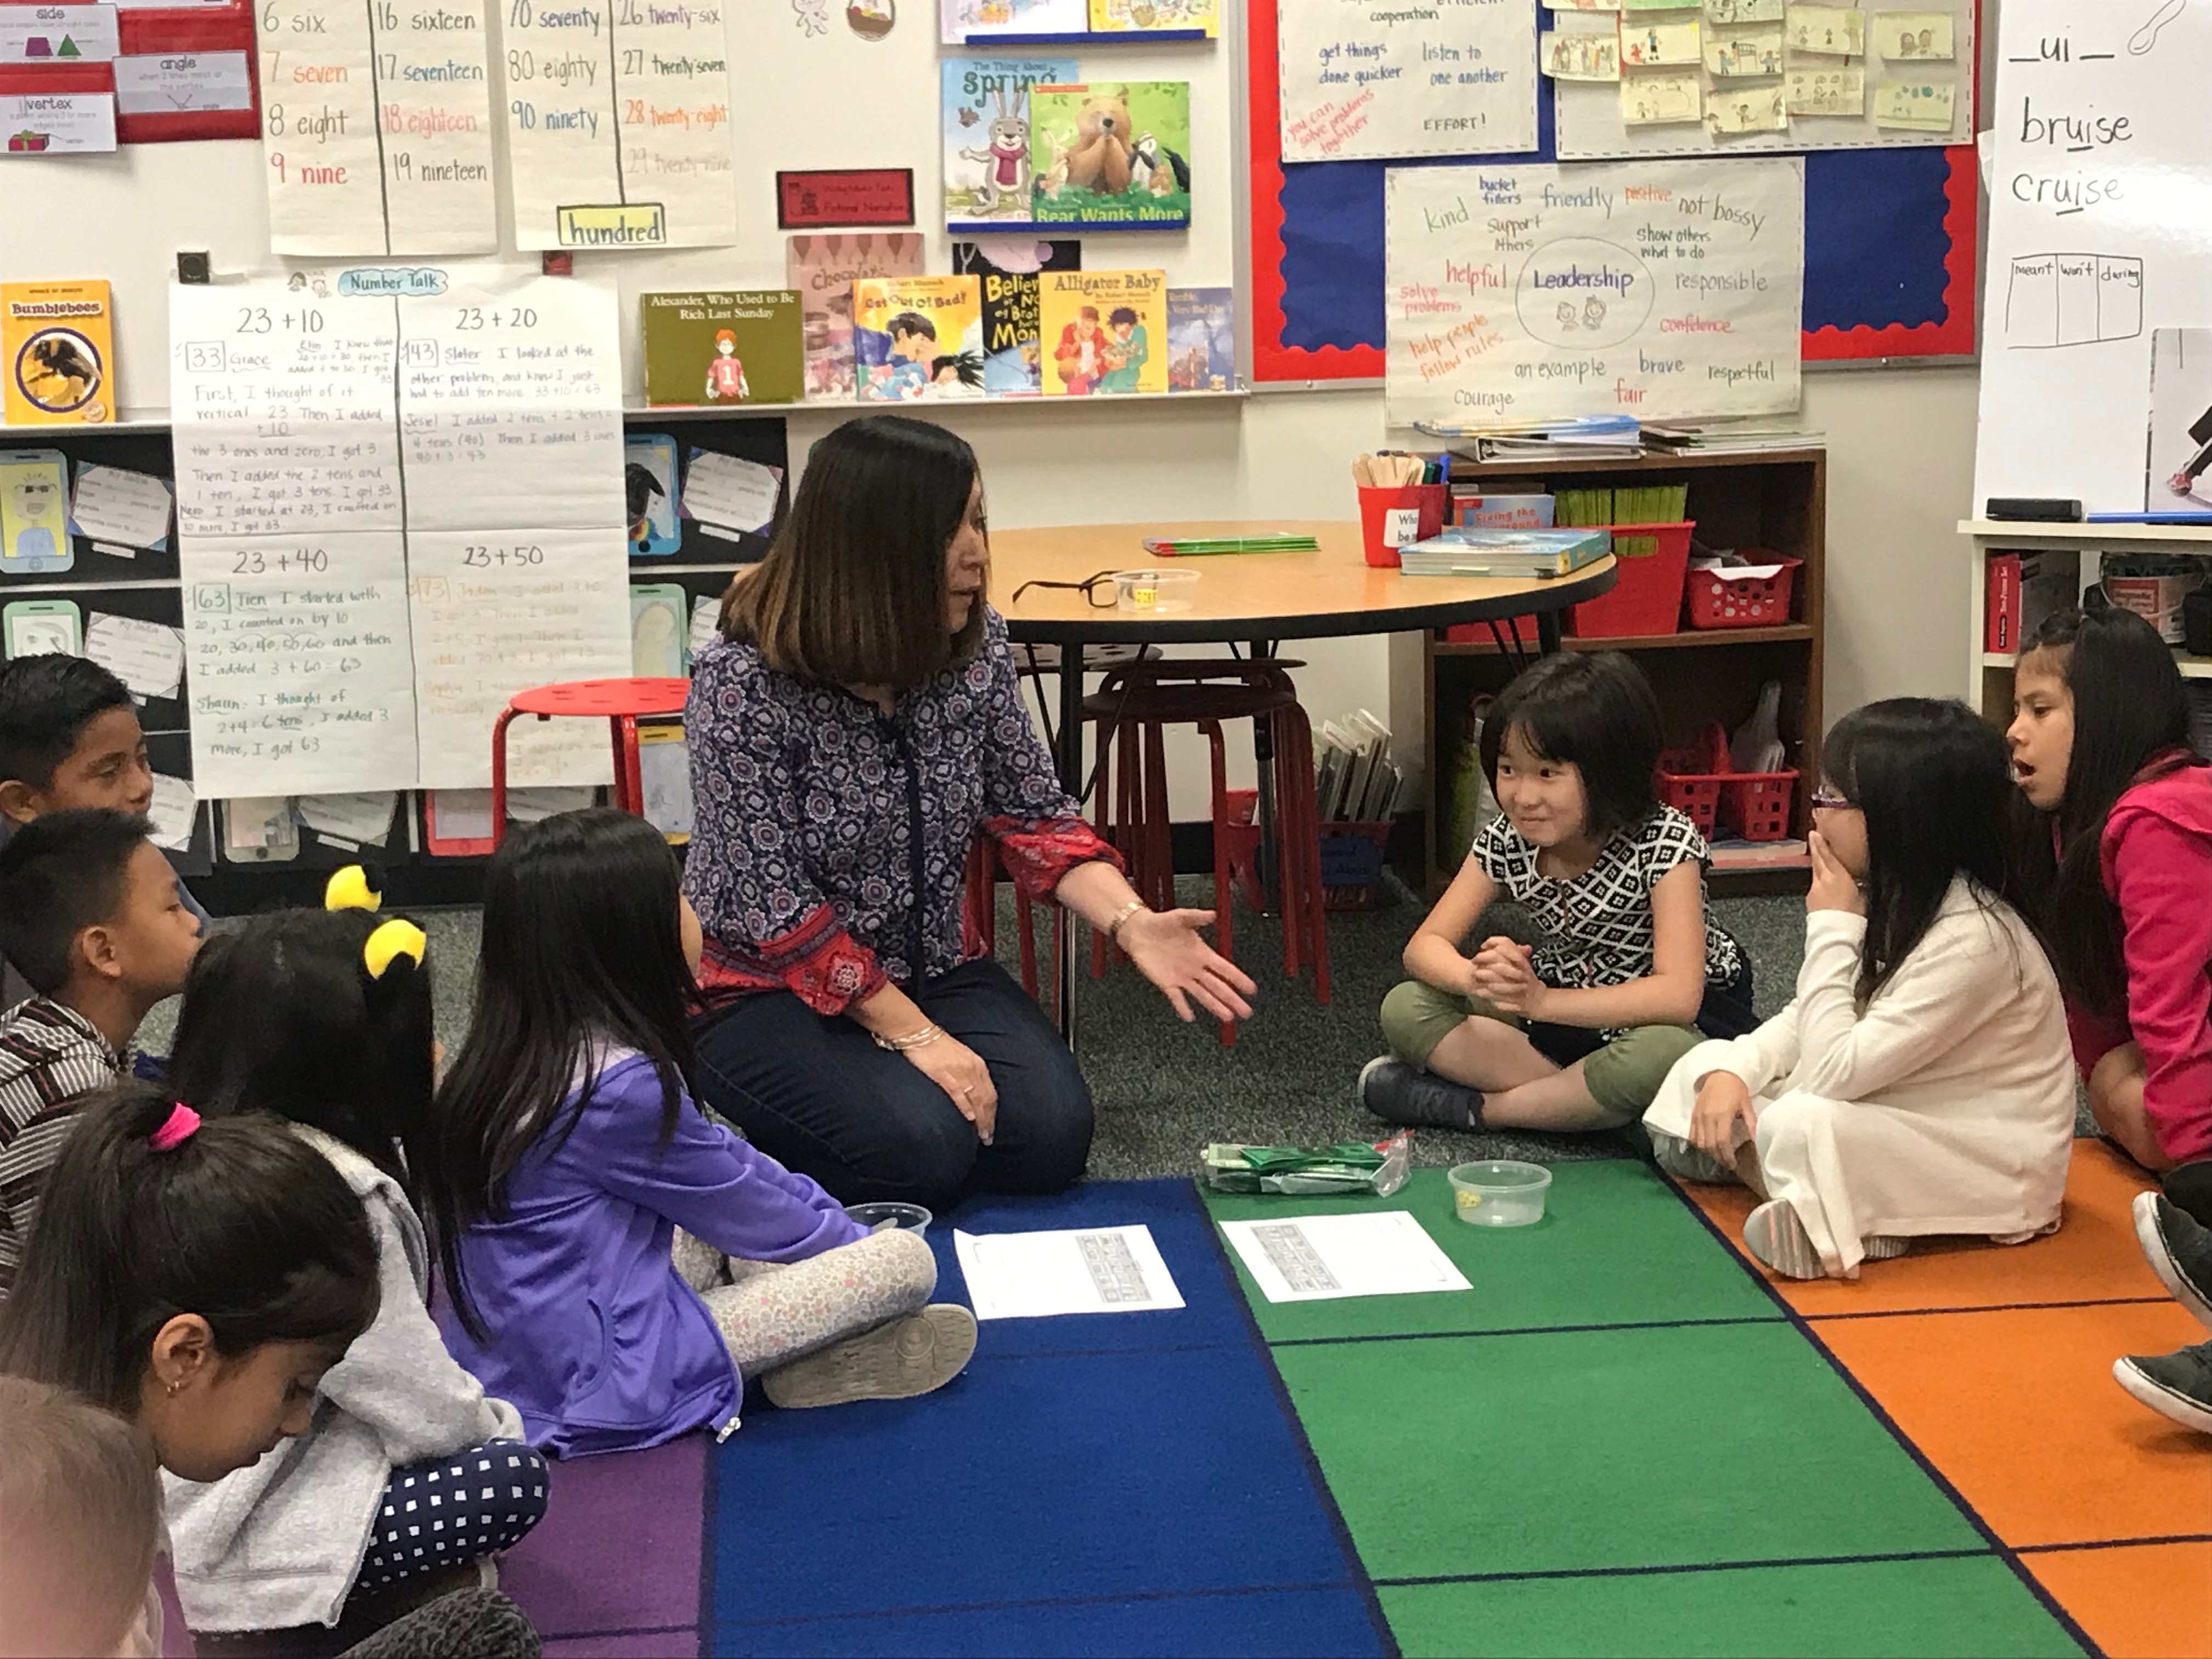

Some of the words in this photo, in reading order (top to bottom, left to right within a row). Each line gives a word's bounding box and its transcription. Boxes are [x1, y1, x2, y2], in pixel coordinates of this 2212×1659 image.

[36, 7, 65, 19] side
[263, 2, 280, 32] 6
[292, 9, 326, 33] six
[378, 2, 398, 31] 16
[412, 9, 476, 31] sixteen
[539, 7, 600, 37] seventy
[619, 0, 643, 26] 26
[649, 4, 720, 30] twenty-six
[1370, 7, 1440, 27] cooperation
[160, 54, 197, 71] angle
[1319, 42, 1340, 66] get
[1345, 41, 1388, 61] things
[1423, 42, 1459, 61] listen
[1466, 45, 1482, 59] to
[266, 51, 280, 82] 7
[294, 66, 348, 83] seven
[379, 54, 396, 80] 17
[403, 59, 483, 82] seventeen
[509, 49, 534, 82] 80
[544, 52, 597, 87] eighty
[623, 49, 643, 75] 27
[651, 53, 726, 80] twenty-seven
[973, 62, 989, 70] The
[992, 61, 1018, 72] Thing
[1319, 69, 1350, 84] done
[1355, 66, 1403, 86] quicker
[1430, 72, 1452, 86] one
[1458, 67, 1508, 84] another
[27, 98, 72, 110] vertex
[625, 99, 645, 125] 28
[649, 103, 729, 131] twenty-eight
[1310, 102, 1334, 124] can
[1329, 89, 1375, 131] problems
[269, 104, 285, 137] 8
[297, 105, 349, 144] eight
[384, 104, 402, 133] 18
[408, 106, 477, 139] eighteen
[511, 100, 535, 130] 90
[545, 107, 598, 139] ninety
[2021, 96, 2133, 145] bruise
[270, 153, 286, 183] 9
[301, 161, 348, 184] nine
[393, 153, 412, 181] 19
[421, 159, 487, 182] nineteen
[1480, 174, 1517, 191] bucket
[2012, 170, 2125, 207] cruise
[1541, 183, 1613, 219] friendly
[1037, 208, 1077, 222] Bear
[1081, 207, 1133, 222] Wants
[1139, 206, 1183, 221] More
[1424, 196, 1470, 233] kind
[1679, 194, 1710, 215] not
[1713, 194, 1766, 241] bossy
[568, 212, 660, 244] hundred
[1676, 226, 1711, 243] others
[1641, 245, 1669, 259] what
[1676, 245, 1686, 258] to
[1690, 245, 1705, 259] do
[1446, 259, 1506, 296] helpful
[2015, 263, 2054, 276] meant
[2061, 262, 2093, 276] won't
[351, 274, 402, 291] Number
[408, 273, 439, 288] Talk
[1054, 275, 1120, 297] Alligator
[1125, 273, 1161, 290] Baby
[1400, 282, 1438, 300] solve
[1534, 264, 1634, 298] Leadership
[1676, 270, 1768, 301] responsible
[12, 302, 100, 315] Bumblebees
[651, 296, 705, 306] Alexander,
[707, 295, 733, 304] Who
[737, 294, 764, 304] Used
[781, 293, 795, 303] Be
[889, 295, 913, 307] Out
[236, 307, 273, 334] 23
[456, 308, 484, 330] 23
[510, 308, 537, 328] 20
[680, 309, 705, 319] Rich
[708, 308, 731, 318] Last
[735, 308, 774, 319] Sunday
[1404, 302, 1462, 320] problems
[1660, 313, 1735, 334] confidence
[1408, 333, 1442, 358] help
[1446, 313, 1488, 348] people
[230, 353, 271, 366] Grace
[1420, 354, 1462, 383] follow
[1465, 332, 1504, 358] rules
[1639, 348, 1686, 374] brave
[722, 365, 735, 385] 1
[1515, 364, 1533, 379] an
[1538, 358, 1607, 385] example
[1708, 360, 1775, 388] respectful
[265, 385, 312, 403] thought
[1454, 388, 1514, 415] Courage
[1613, 377, 1647, 404] fair
[196, 407, 249, 420] vertical
[301, 408, 329, 421] Then
[192, 469, 223, 483] Then
[1476, 511, 1512, 523] Fixing
[1516, 507, 1535, 517] the
[1397, 530, 1409, 541] be
[233, 551, 266, 574] 23
[297, 549, 328, 572] 40
[462, 546, 492, 567] 23
[514, 546, 544, 567] 50
[199, 588, 226, 609] 63
[301, 590, 344, 604] started
[350, 585, 381, 601] with
[312, 613, 329, 629] by
[217, 663, 256, 675] added
[274, 692, 321, 710] thought
[301, 737, 320, 752] 63
